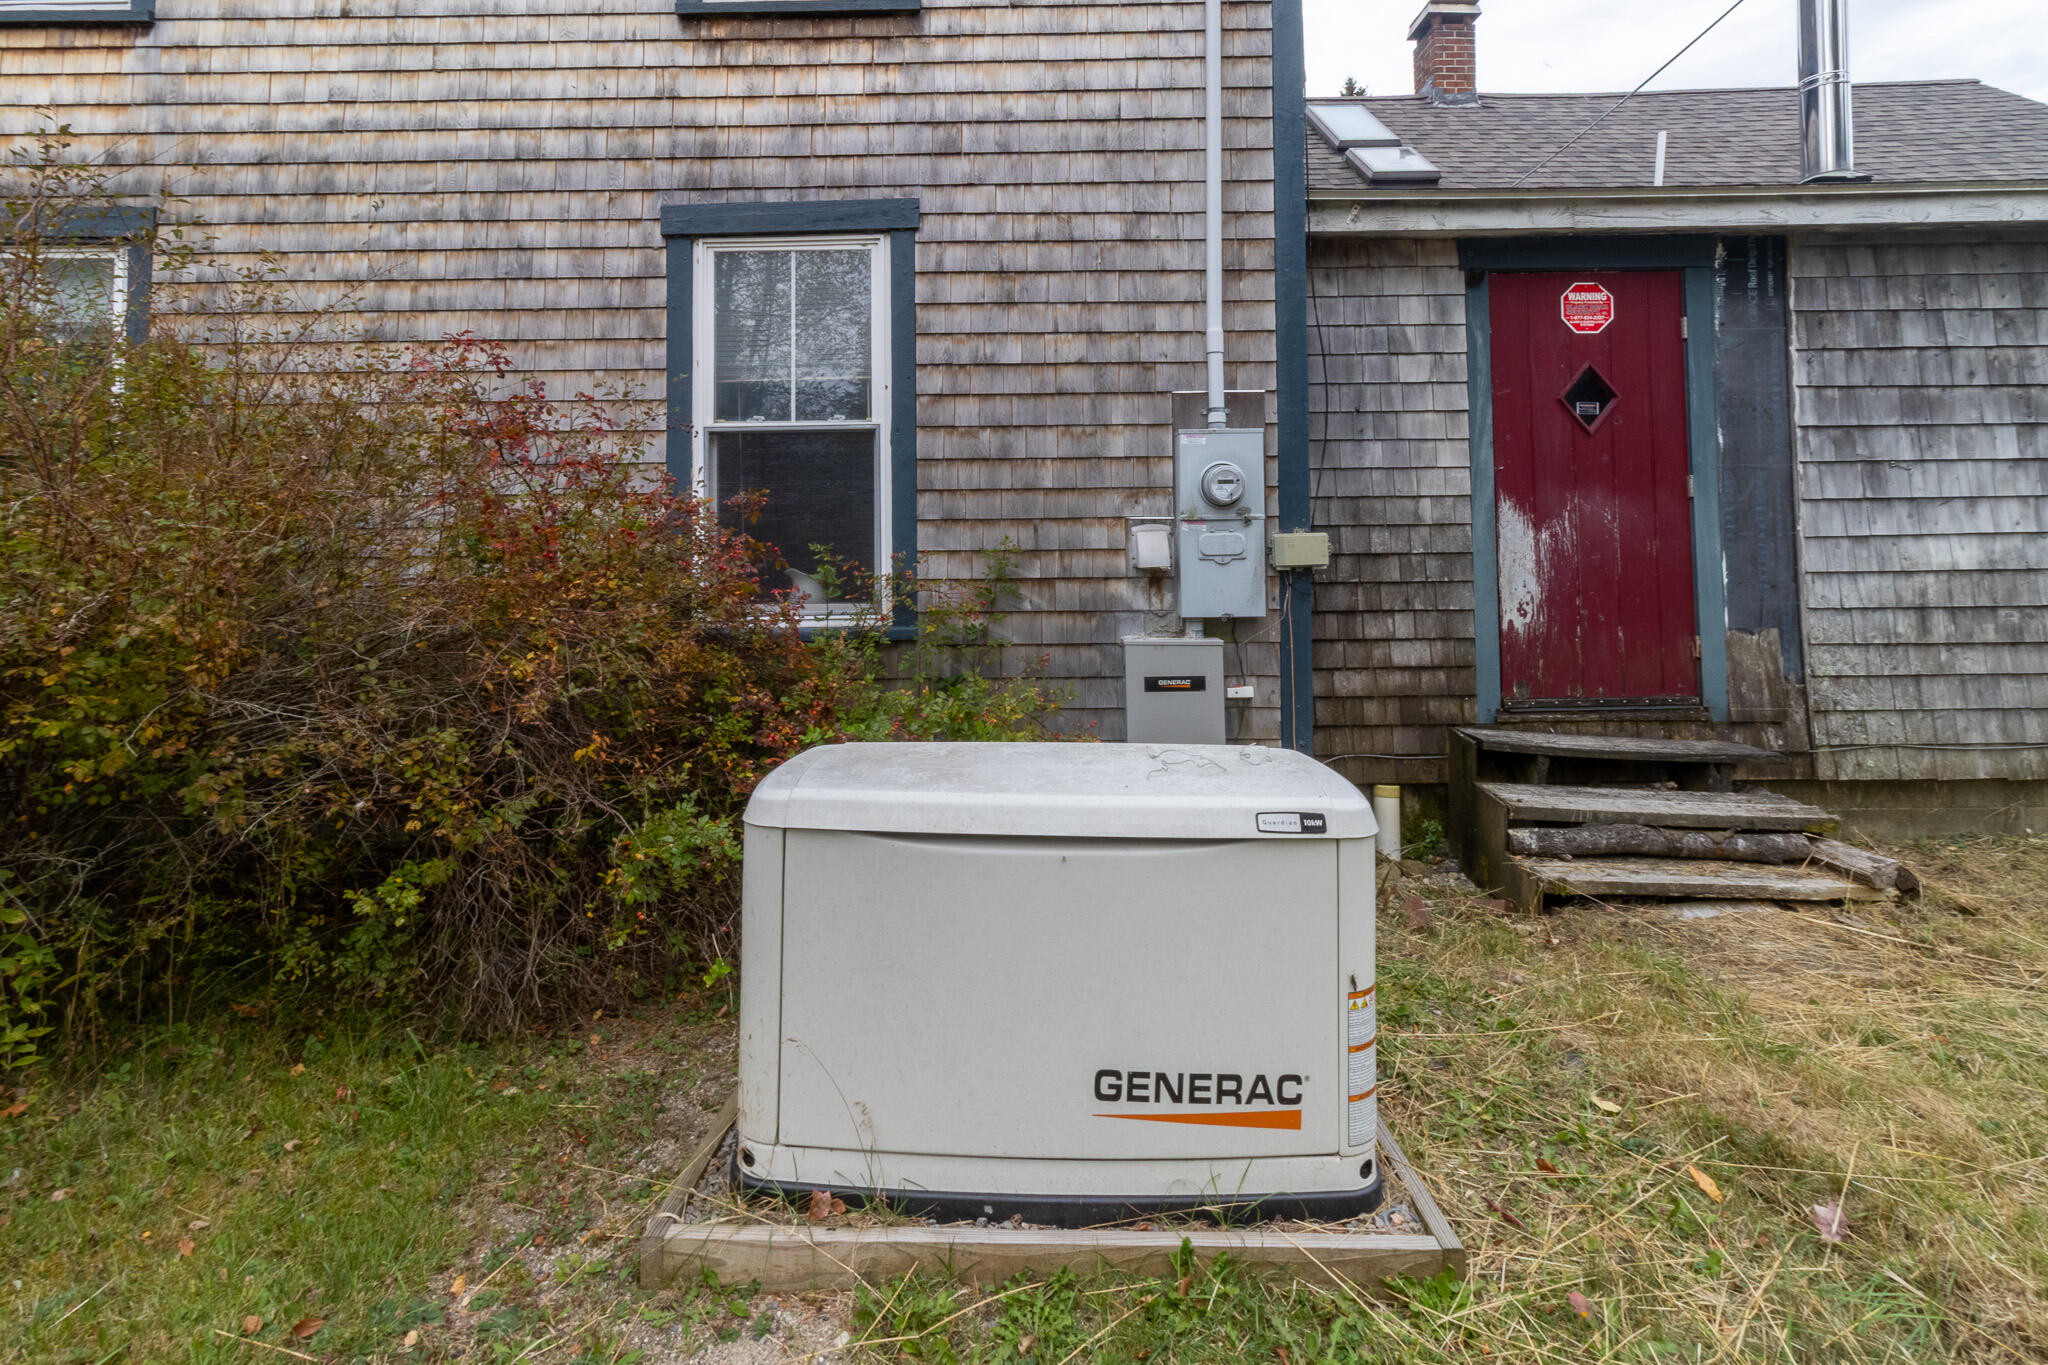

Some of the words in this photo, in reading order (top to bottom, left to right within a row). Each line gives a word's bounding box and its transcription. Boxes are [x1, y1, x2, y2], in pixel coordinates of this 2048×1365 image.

[1747, 269, 1757, 289] Roof
[1568, 292, 1607, 300] WARNING
[1094, 1069, 1303, 1106] GENERAC
